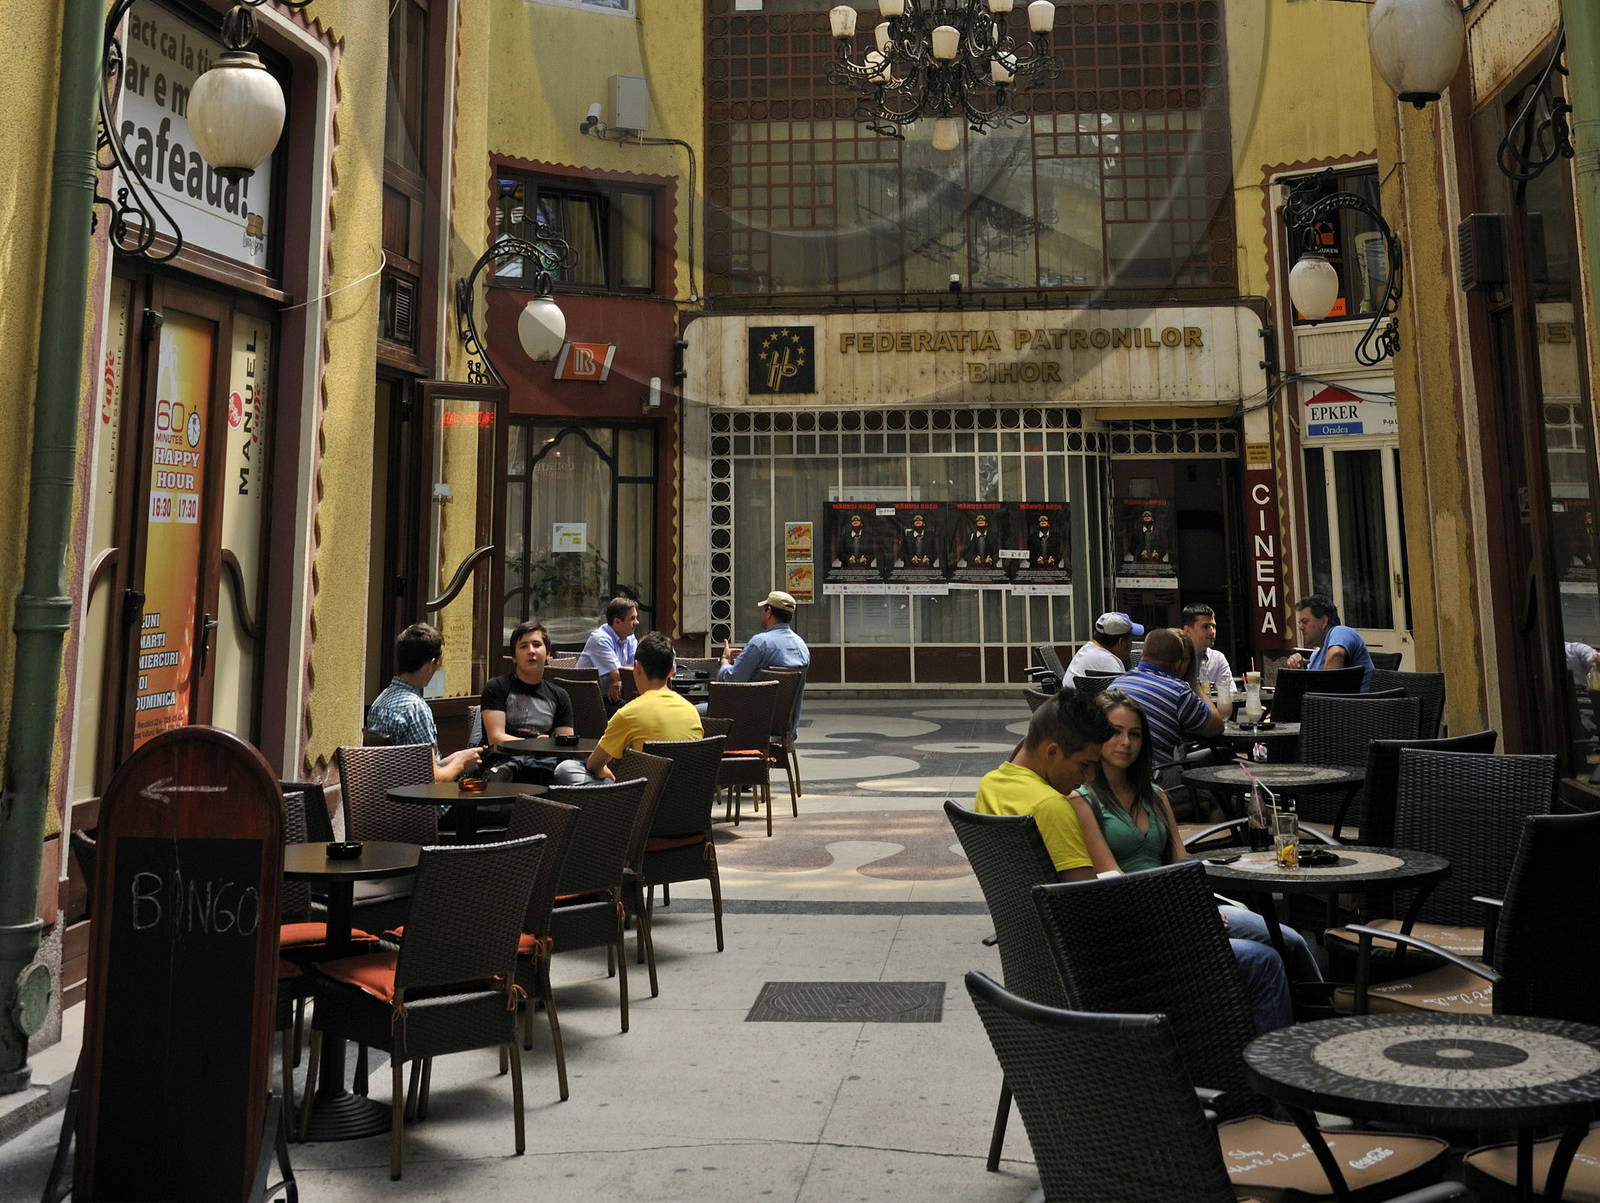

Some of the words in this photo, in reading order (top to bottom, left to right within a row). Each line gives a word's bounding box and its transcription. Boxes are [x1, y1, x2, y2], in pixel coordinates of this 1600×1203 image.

[128, 12, 157, 50] act
[161, 33, 177, 61] ca
[181, 34, 194, 71] la
[154, 73, 167, 107] e
[840, 329, 1000, 353] FEDERATIA
[1014, 326, 1204, 351] PATRONILOR
[968, 361, 1062, 384] BIHOR
[156, 399, 185, 433] 60
[238, 330, 258, 496] MANUEL
[1311, 405, 1358, 421] EPKER
[155, 432, 183, 445] MINUTES
[1322, 425, 1348, 434] Oradea
[154, 446, 200, 469] HAPPY
[156, 470, 195, 490] HOUR
[152, 497, 172, 517] 16:30
[178, 498, 197, 518] 17:30
[1252, 483, 1278, 634] CINEMA
[140, 632, 166, 649] MARTI
[138, 651, 179, 669] MIERCURI
[138, 675, 149, 690] OI
[132, 871, 260, 936] BINGO
